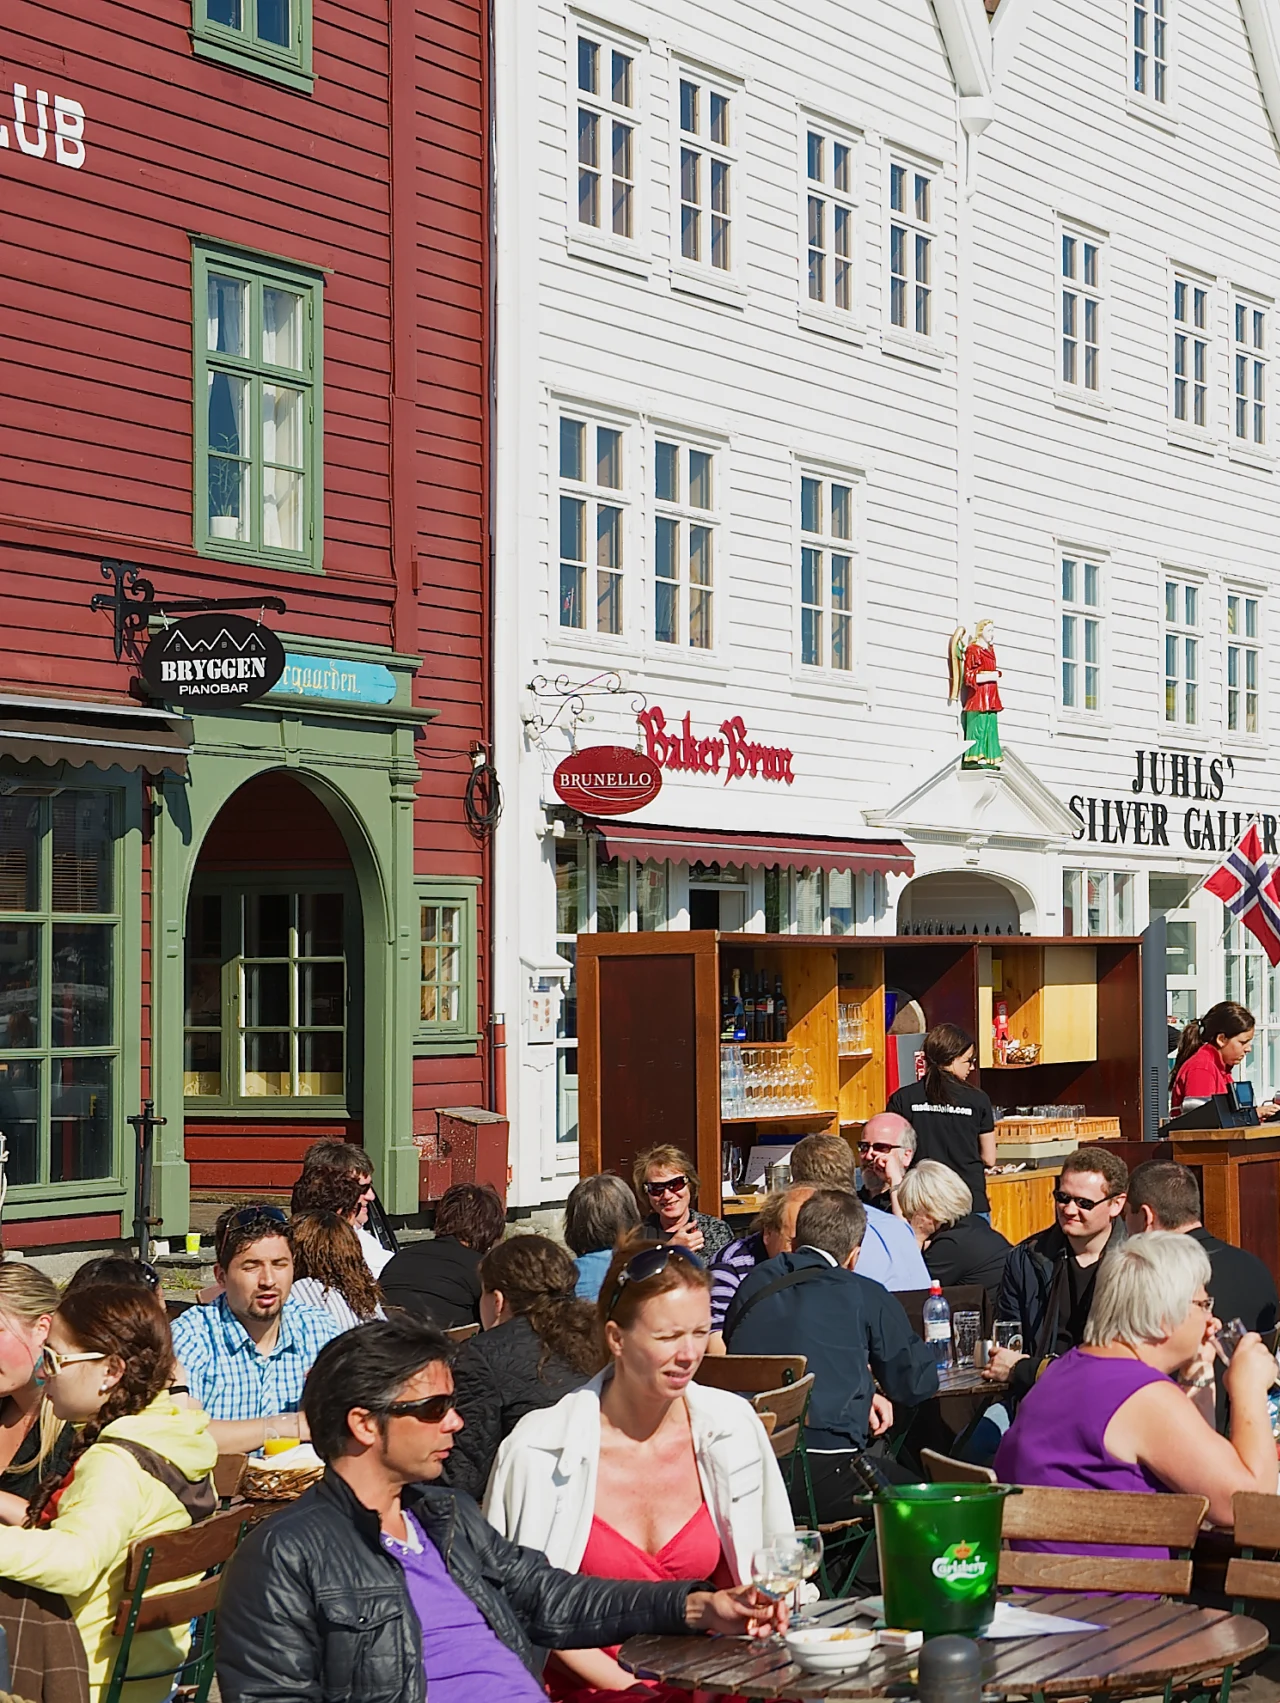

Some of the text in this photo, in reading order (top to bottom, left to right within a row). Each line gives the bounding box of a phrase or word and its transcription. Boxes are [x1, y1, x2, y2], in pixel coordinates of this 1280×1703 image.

[0, 82, 86, 169] UB
[161, 656, 267, 682] BRYGGEN
[179, 682, 249, 696] PIANOBAR
[636, 706, 795, 787] Baker Brun
[560, 772, 652, 787] BRUNELLO
[1069, 794, 1170, 847] SILVER
[931, 1555, 988, 1578] Carlsberg
